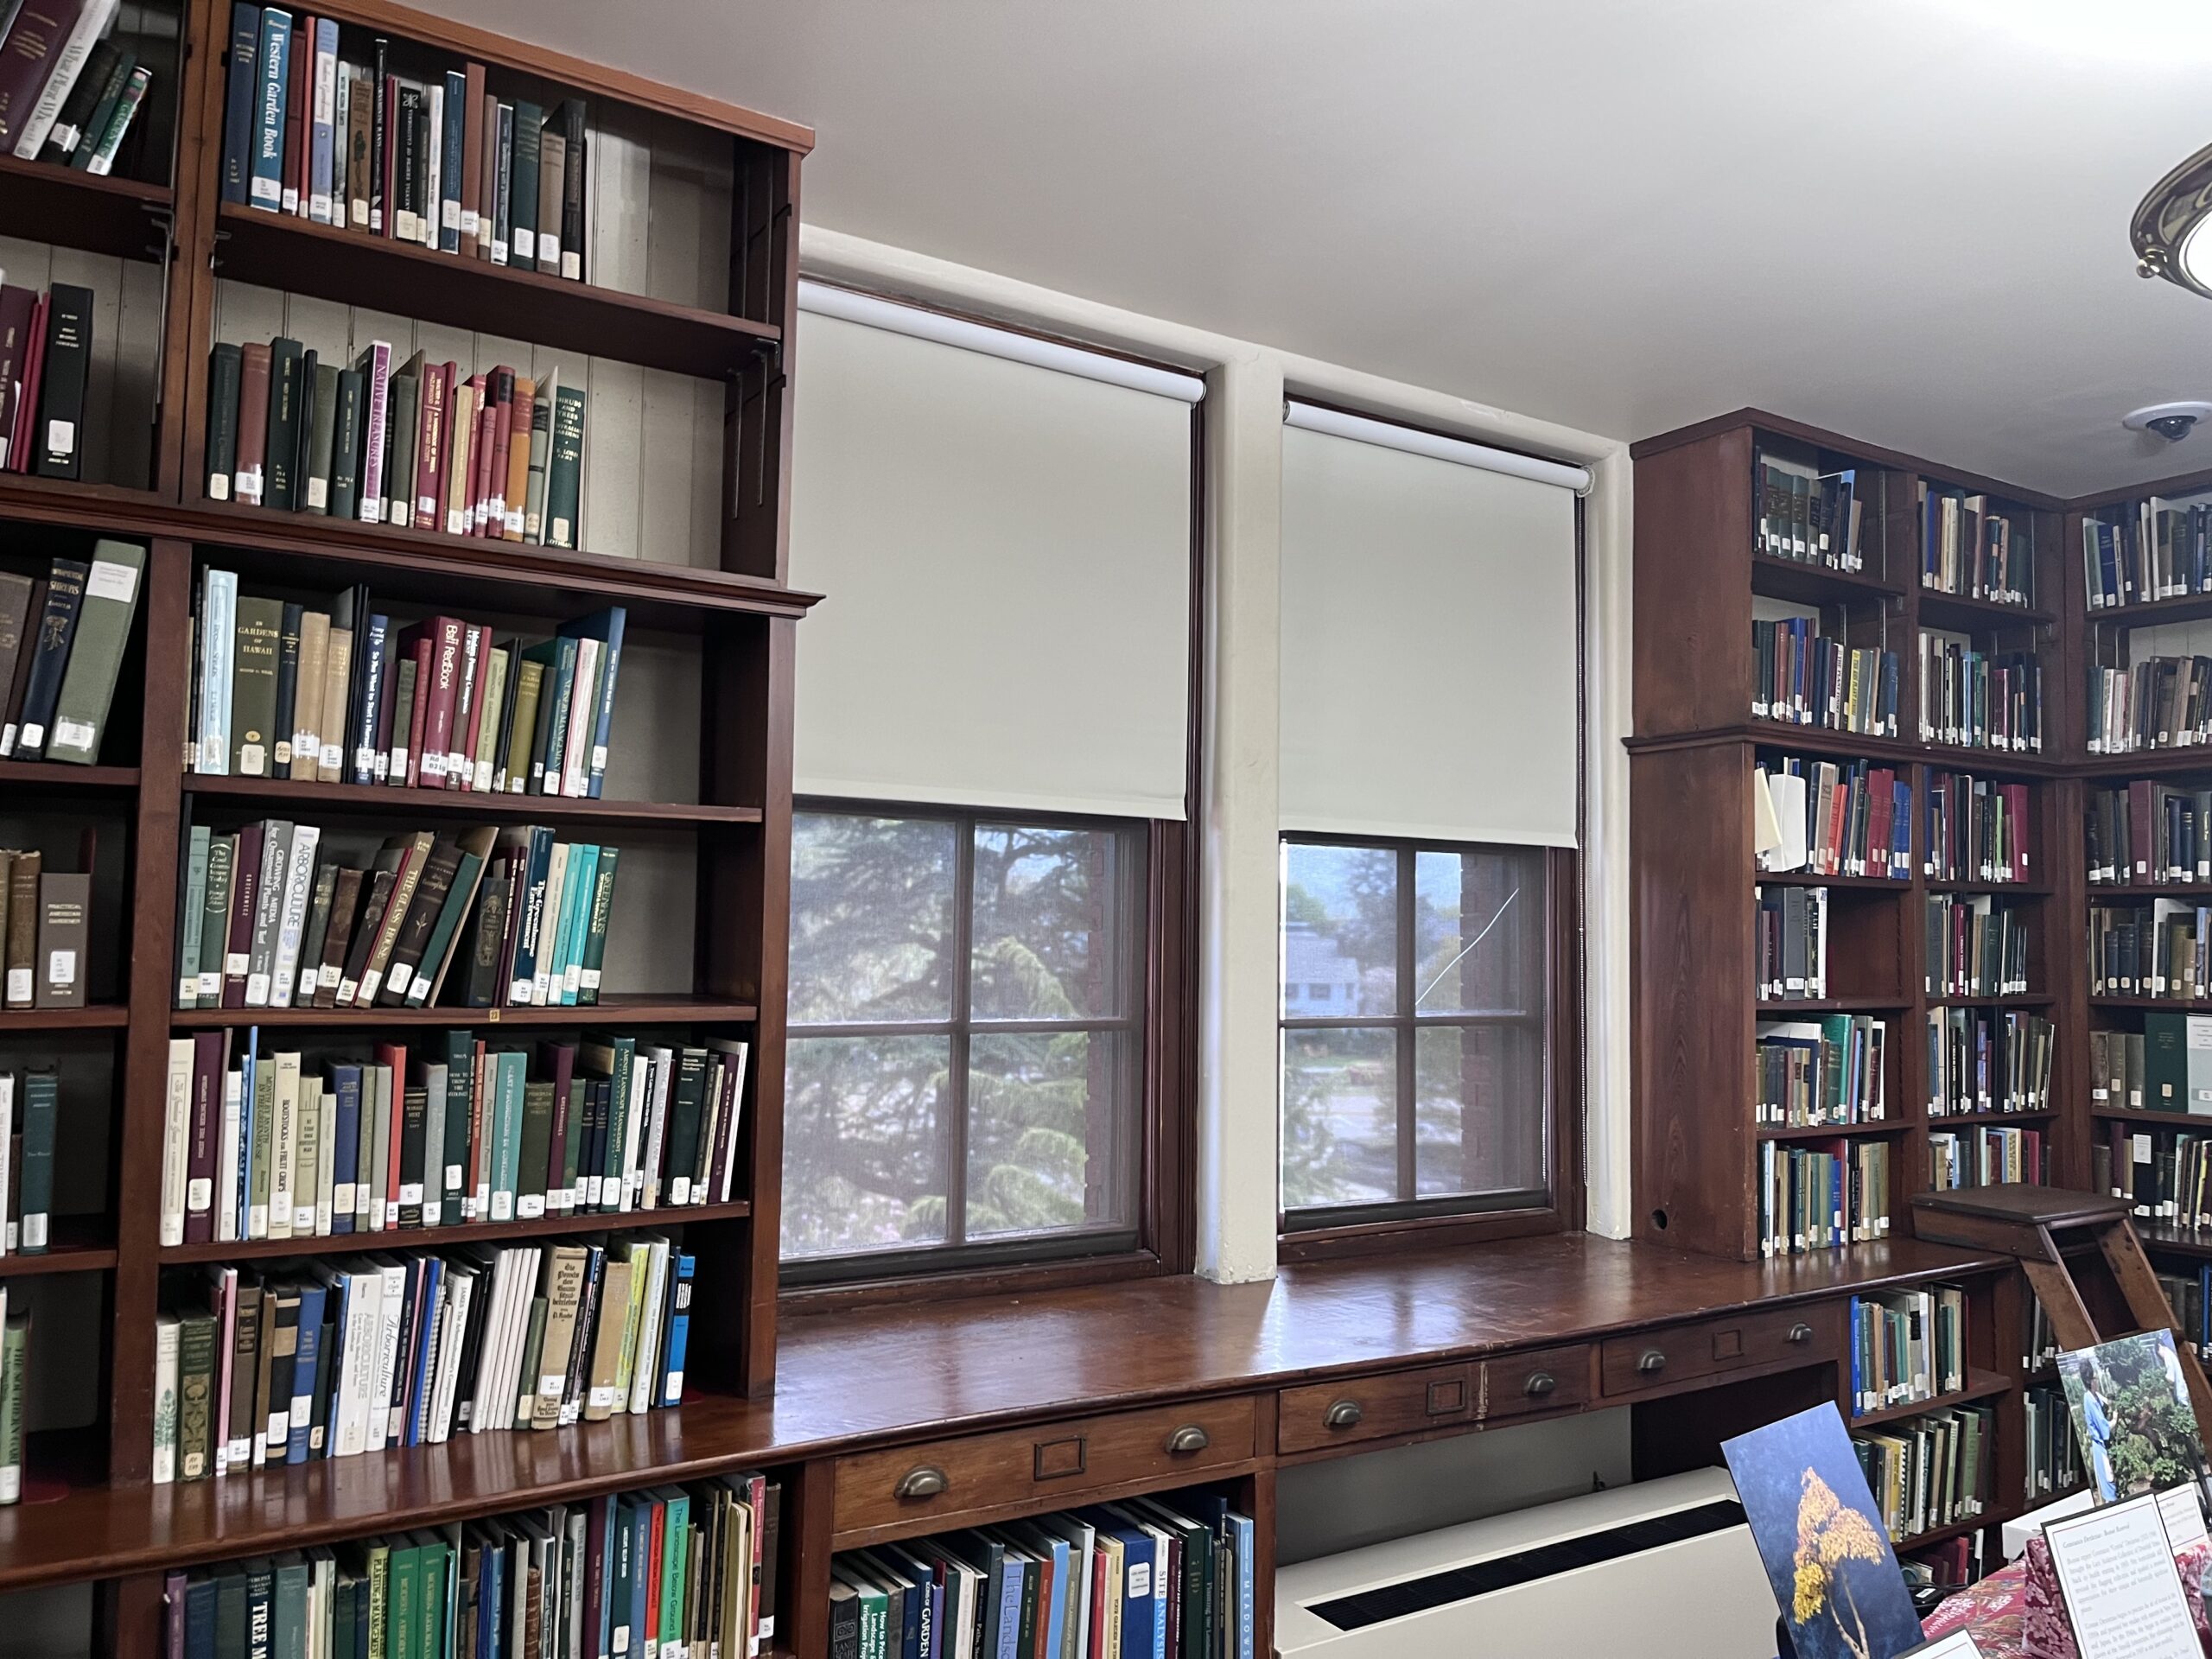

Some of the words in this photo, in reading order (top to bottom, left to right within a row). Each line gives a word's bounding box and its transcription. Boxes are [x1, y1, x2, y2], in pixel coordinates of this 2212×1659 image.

[267, 32, 284, 78] Western
[264, 82, 280, 124] Garden
[262, 128, 278, 159] Book
[372, 364, 386, 404] NATIVE
[562, 404, 575, 413] AND
[367, 408, 383, 467] TREASURES
[429, 417, 439, 446] HANDBOOK
[237, 626, 280, 639] GARDENS
[242, 645, 273, 655] HAWAII
[444, 625, 459, 644] Ball
[468, 630, 480, 656] Modern
[372, 651, 378, 660] So
[439, 645, 454, 690] RedBook
[368, 674, 377, 691] Want
[560, 677, 571, 713] NURSERY
[553, 714, 568, 772] MANAGEMENT
[270, 826, 279, 837] for
[263, 840, 277, 886] Ornamental
[271, 849, 284, 891] GROWING
[402, 868, 418, 892] THE
[261, 887, 271, 910] Plants
[287, 842, 311, 927] ARBORICULTURE
[537, 880, 546, 895] The
[259, 912, 268, 926] and
[268, 897, 278, 923] MEDIA
[390, 892, 409, 925] GLASS
[523, 887, 539, 950] Environment
[529, 896, 544, 957] Greenhouse
[376, 926, 396, 961] HOUSE
[264, 1104, 270, 1114] BY
[619, 1077, 627, 1109] LANDSCAPE
[281, 1099, 289, 1140] ROOTSTOCKS
[503, 1090, 512, 1136] PRODUCTION
[614, 1110, 624, 1152] MANAGEMENT
[255, 1109, 264, 1160] GREENHOUSE
[502, 1138, 509, 1147] IN
[564, 1263, 575, 1272] Die
[458, 1286, 467, 1308] JAMES
[358, 1313, 373, 1399] ARBORICULTURE
[378, 1313, 399, 1397] Arboriculture
[671, 1525, 682, 1570] Landscape
[372, 1558, 383, 1596] PLANTING
[1004, 1570, 1020, 1602] The
[250, 1600, 270, 1644] TREE
[369, 1605, 381, 1658] MANAGEMENT
[669, 1599, 677, 1630] Ground
[860, 1604, 868, 1640] Irrigation
[868, 1613, 877, 1652] Landscape
[919, 1607, 931, 1657] GARDEN
[1156, 1600, 1165, 1658] ANALYSIS
[879, 1630, 885, 1639] to
